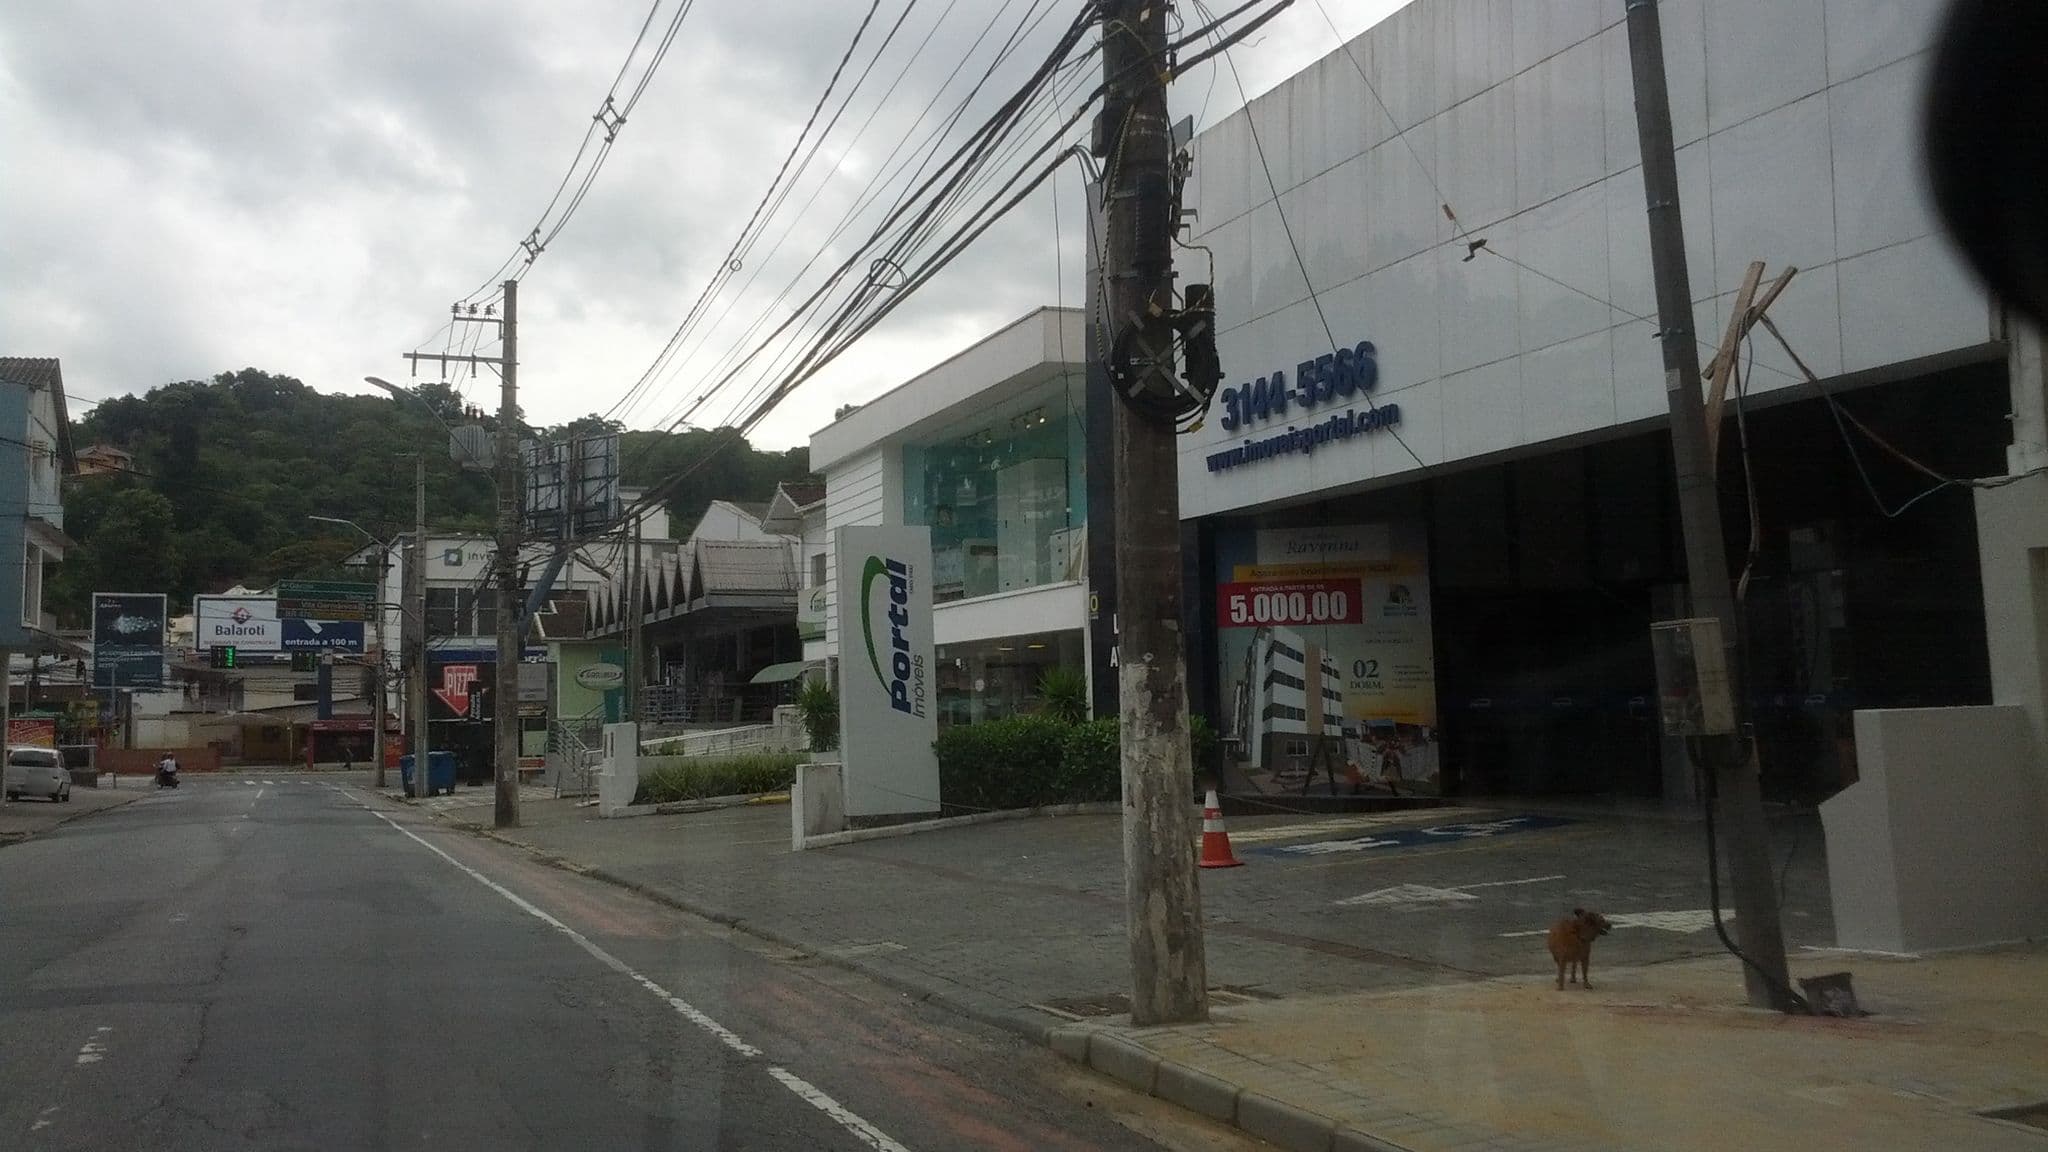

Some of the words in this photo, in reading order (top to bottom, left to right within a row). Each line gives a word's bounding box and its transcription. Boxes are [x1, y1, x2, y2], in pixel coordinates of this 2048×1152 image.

[1220, 341, 1378, 430] 3144-5566
[1230, 590, 1347, 624] 5.000,00
[215, 624, 265, 636] Balaroti
[285, 638, 320, 646] entrada
[330, 638, 346, 646] 100
[1353, 659, 1379, 679] 02
